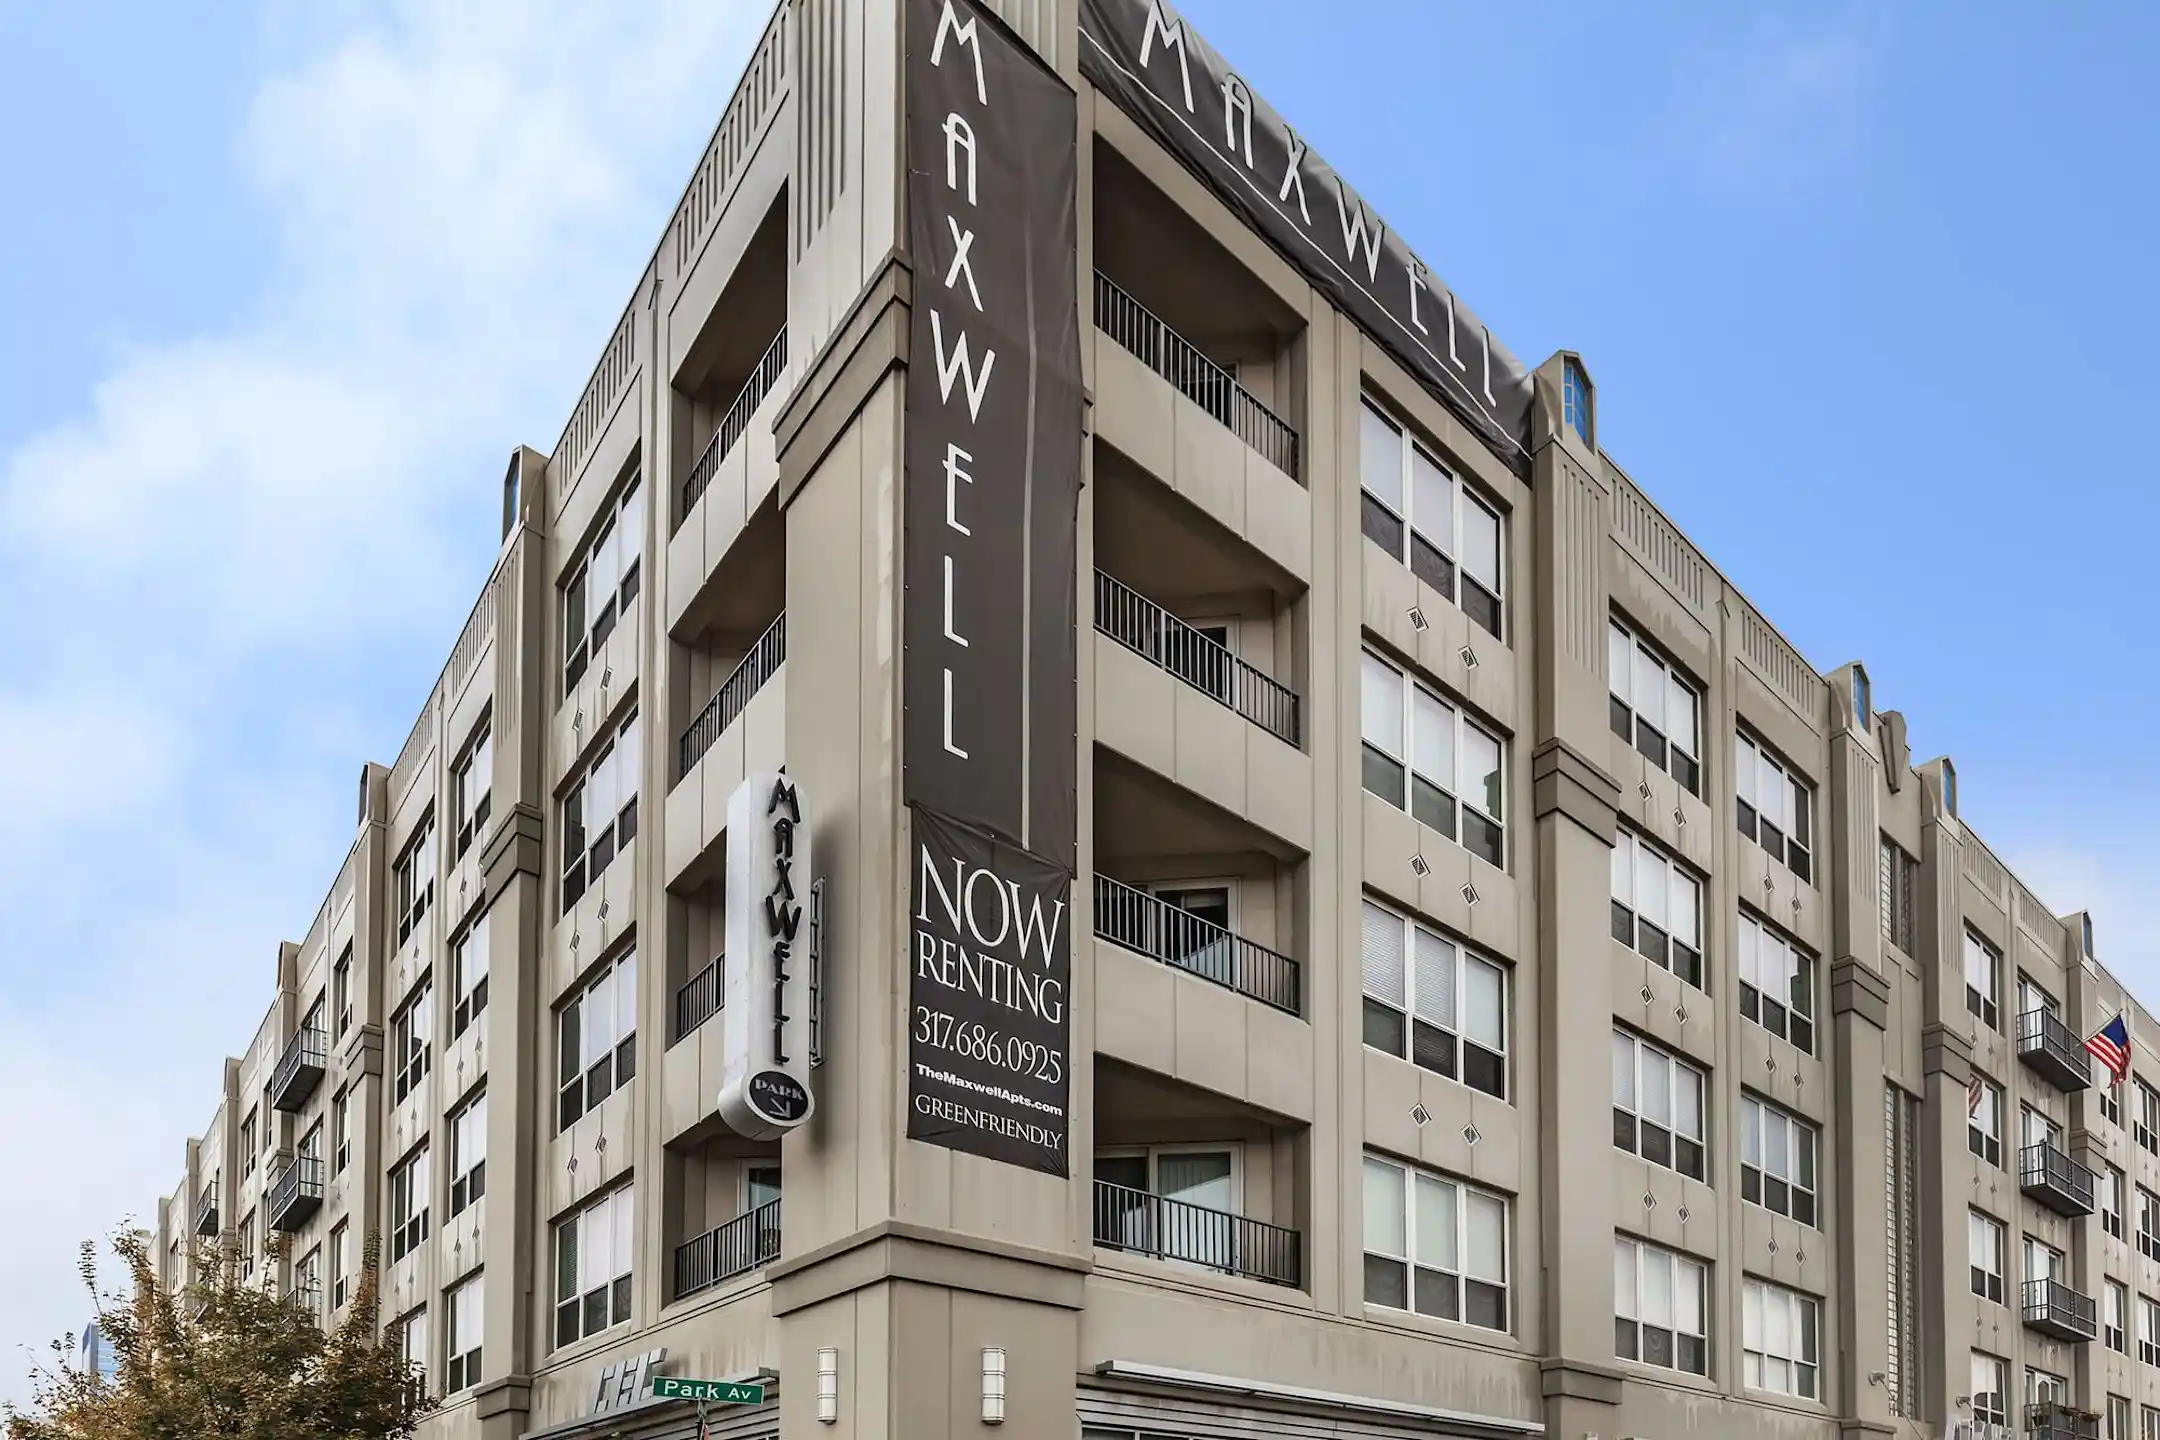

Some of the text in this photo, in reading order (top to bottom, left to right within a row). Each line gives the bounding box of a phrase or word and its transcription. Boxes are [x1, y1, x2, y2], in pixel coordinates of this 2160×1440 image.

[1139, 0, 1496, 407] MAXWELL
[930, 0, 996, 760] MAXWELL
[765, 777, 802, 1064] MAXWELL
[916, 843, 1065, 969] NOW
[916, 929, 1063, 1024] RENTING
[915, 1005, 1063, 1085] 317.686.0925
[755, 1079, 804, 1101] PARK
[915, 1094, 1063, 1150] GREENFRIENDLY
[916, 1063, 1063, 1116] TheMaxwellApts.com
[664, 1380, 752, 1400] Park Av
